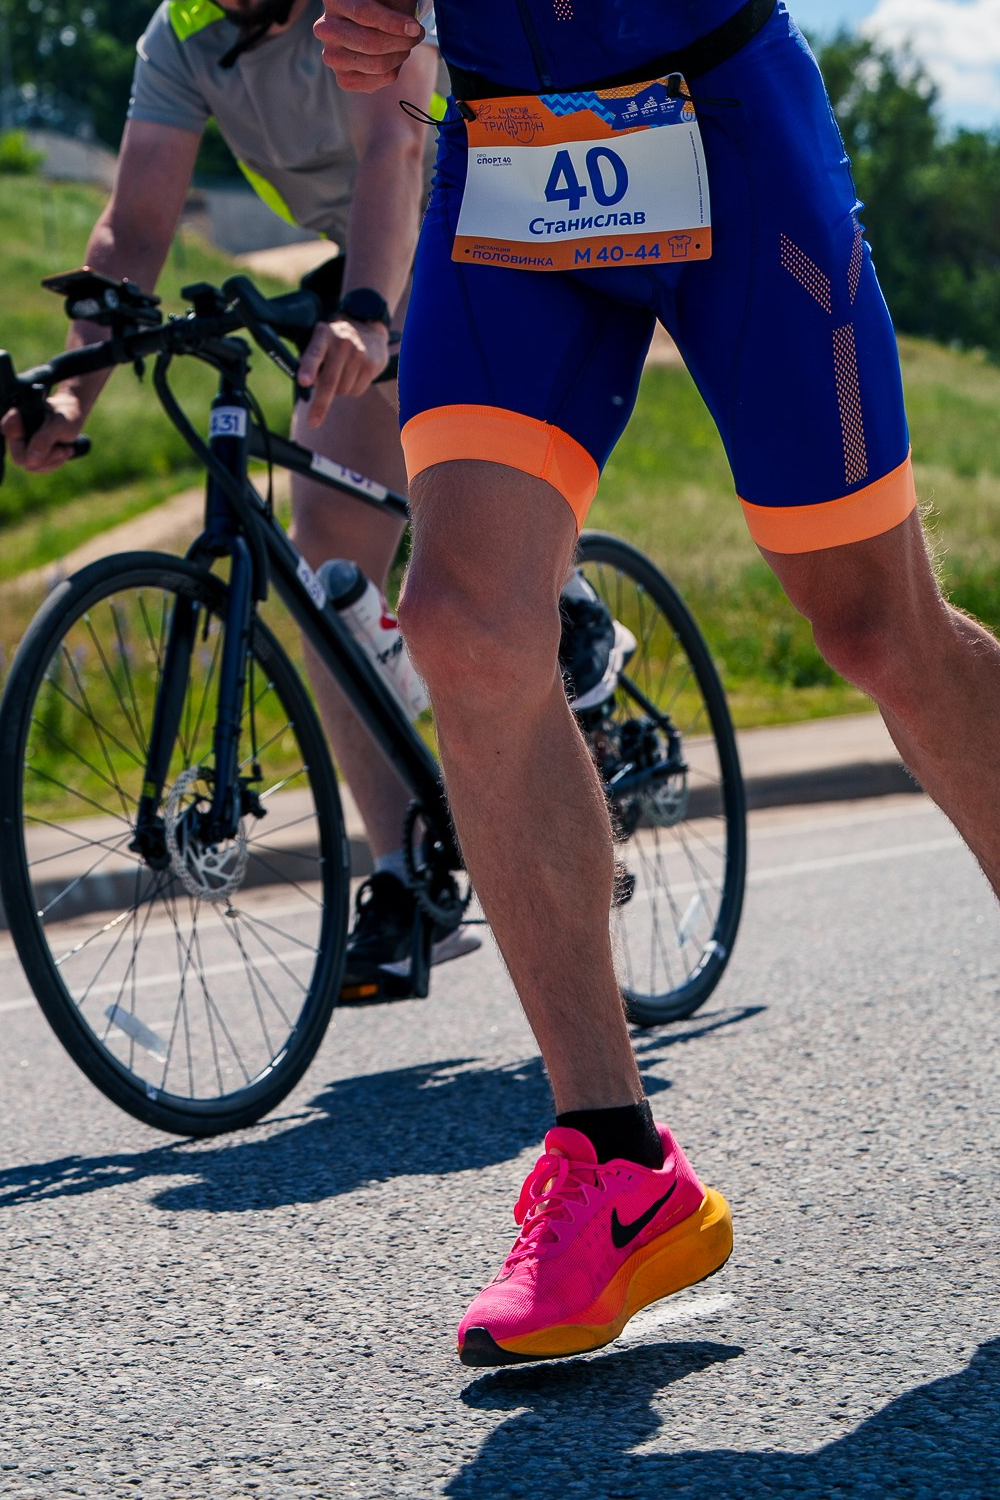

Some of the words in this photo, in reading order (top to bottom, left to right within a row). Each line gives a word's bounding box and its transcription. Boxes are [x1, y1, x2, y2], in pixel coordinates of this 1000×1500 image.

[477, 157, 502, 165] СПОРТ
[544, 146, 629, 211] 40
[528, 210, 647, 235] Станислав
[473, 244, 511, 253] ДИСТАНЦИЯ
[596, 243, 661, 263] 40-44
[472, 250, 554, 267] ПОЛОВИНКА
